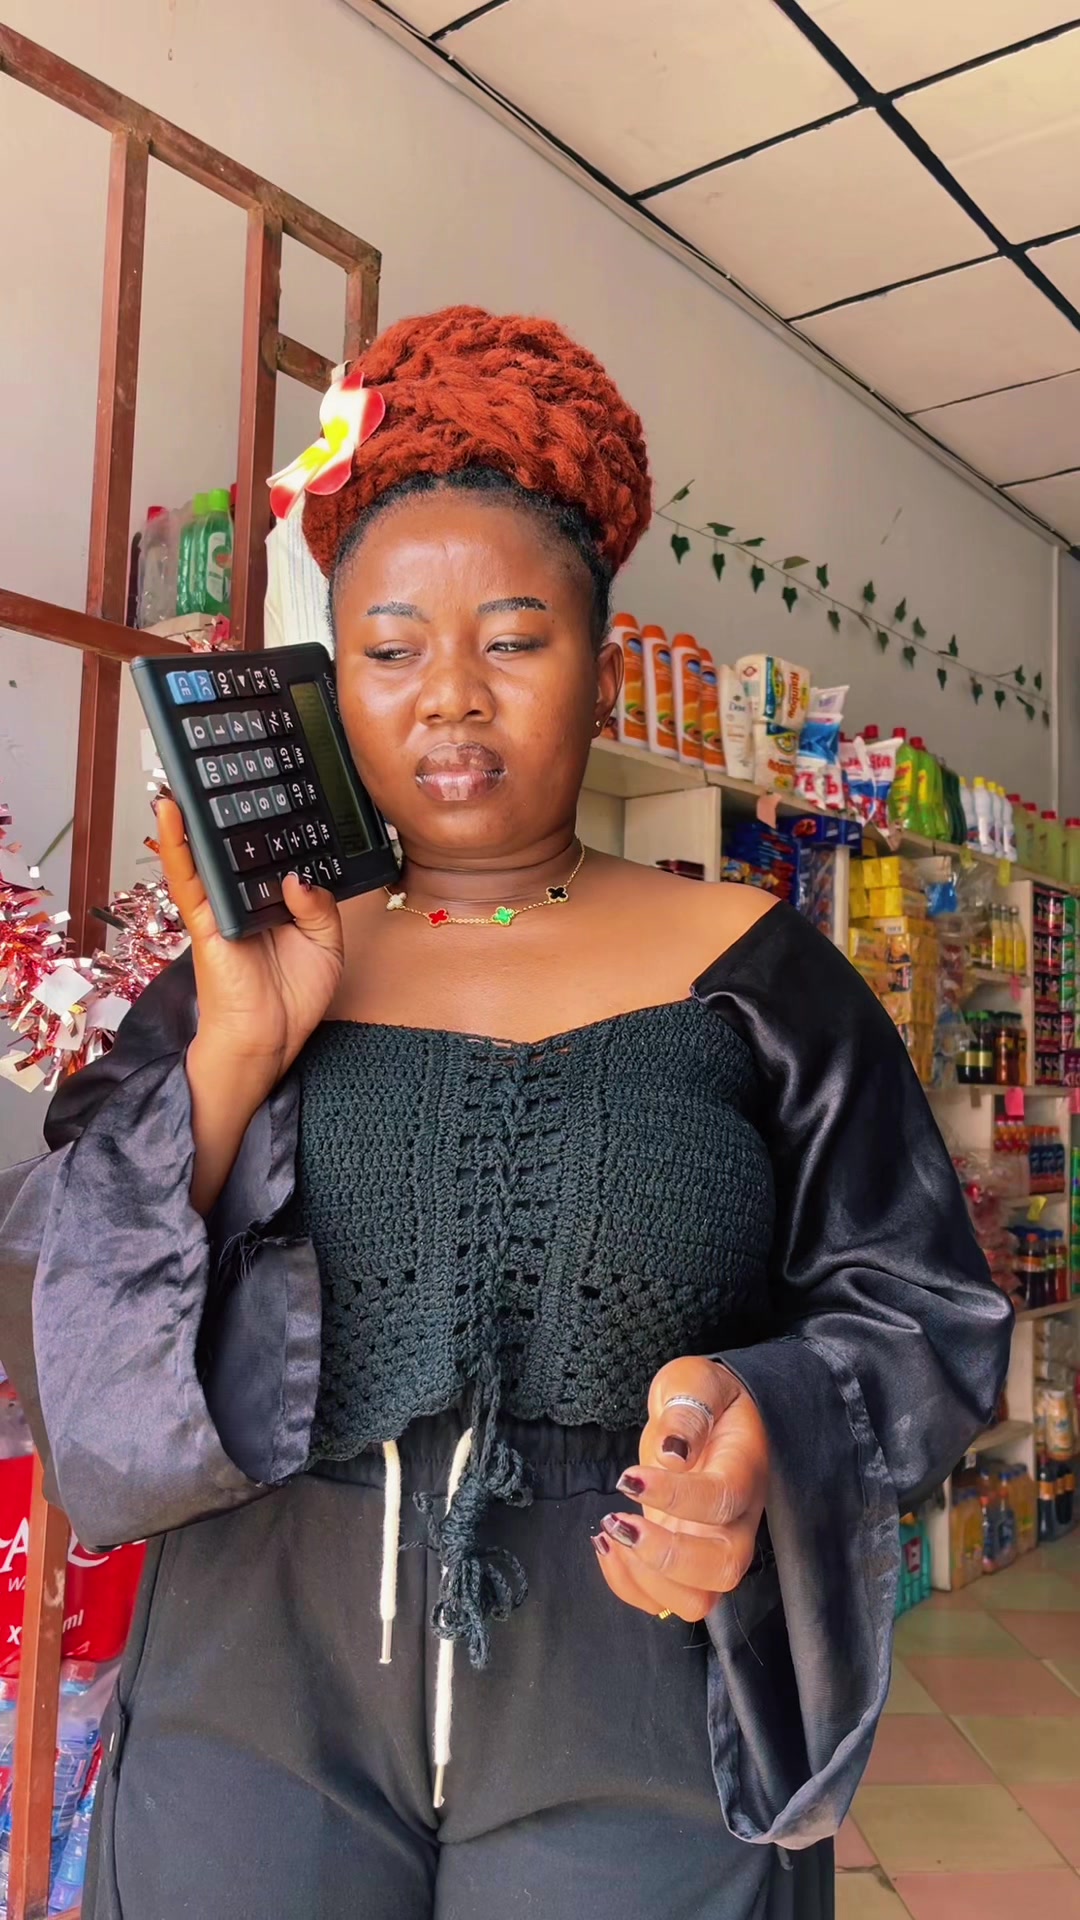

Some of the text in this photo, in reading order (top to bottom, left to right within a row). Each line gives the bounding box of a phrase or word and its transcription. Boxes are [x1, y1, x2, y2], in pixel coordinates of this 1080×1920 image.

[178, 677, 192, 696] CE
[198, 676, 212, 696] AC
[217, 672, 232, 695] ON
[254, 670, 266, 690] EX
[788, 672, 800, 719] Rainbow
[233, 720, 244, 734] 4
[251, 718, 263, 732] 7
[283, 712, 294, 729] MC
[194, 725, 206, 740] 0
[215, 725, 226, 735] 1
[264, 756, 274, 769] 8
[295, 747, 304, 764] MR
[206, 761, 221, 784] 00
[226, 762, 239, 776] 2
[246, 760, 258, 773] 5
[240, 800, 252, 814] 3
[258, 797, 270, 810] 6
[276, 793, 287, 806] 9
[244, 841, 256, 858] +
[332, 858, 342, 876] MU
